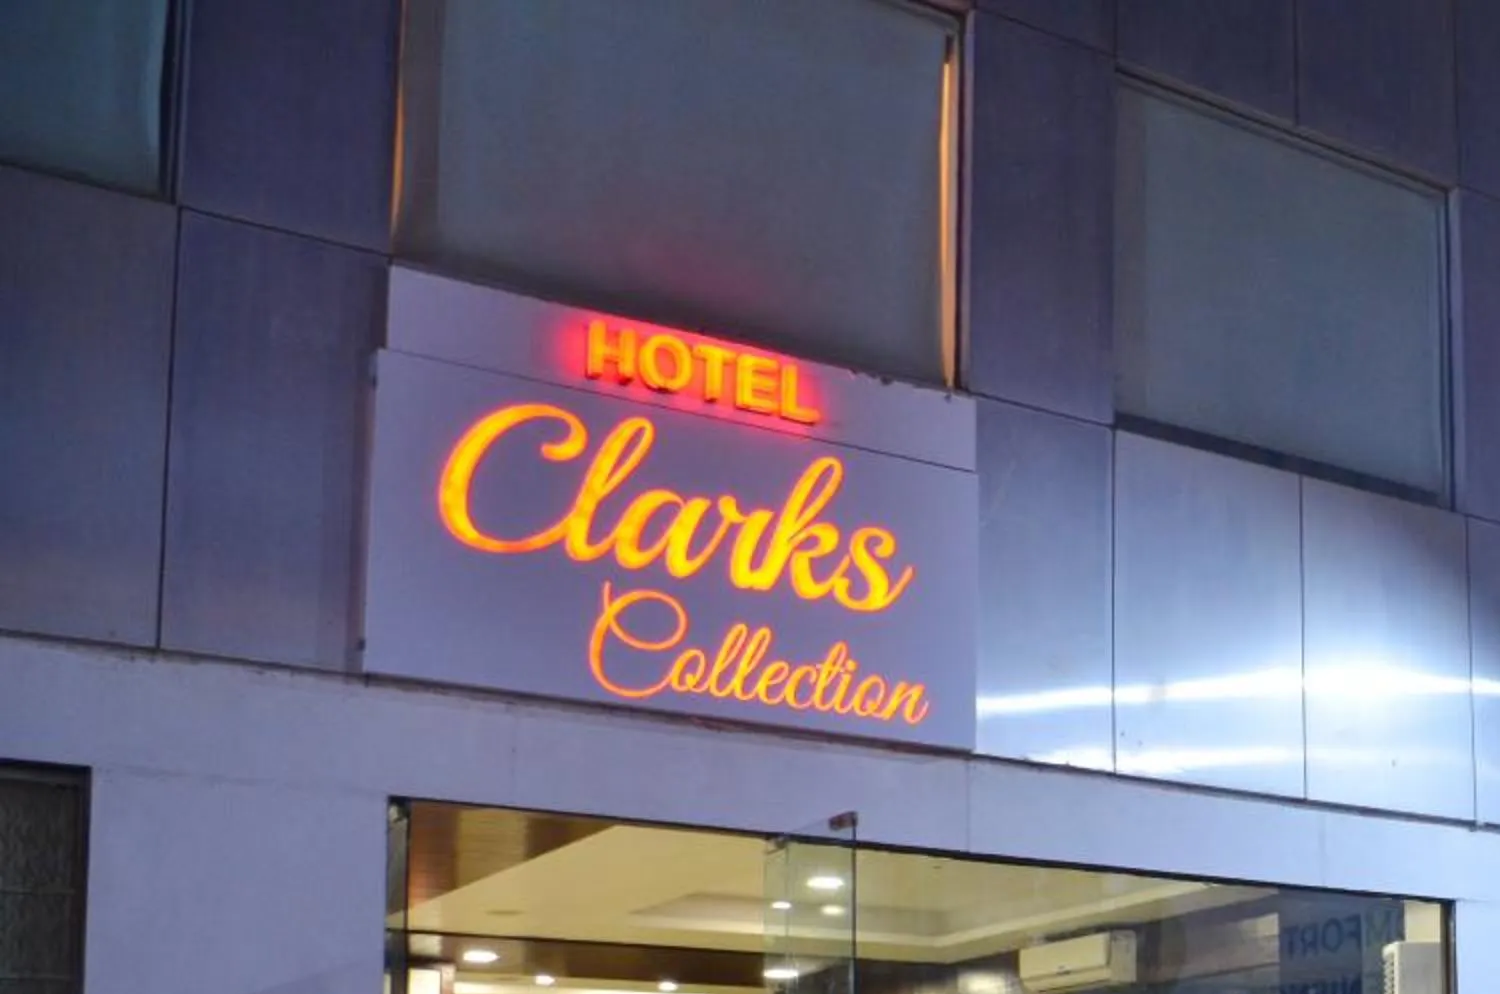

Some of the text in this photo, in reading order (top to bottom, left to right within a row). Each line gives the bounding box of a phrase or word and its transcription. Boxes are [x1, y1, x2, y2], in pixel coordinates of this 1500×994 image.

[585, 320, 821, 425] HOTEL
[438, 403, 914, 611] Clarks
[589, 581, 929, 724] Collection
